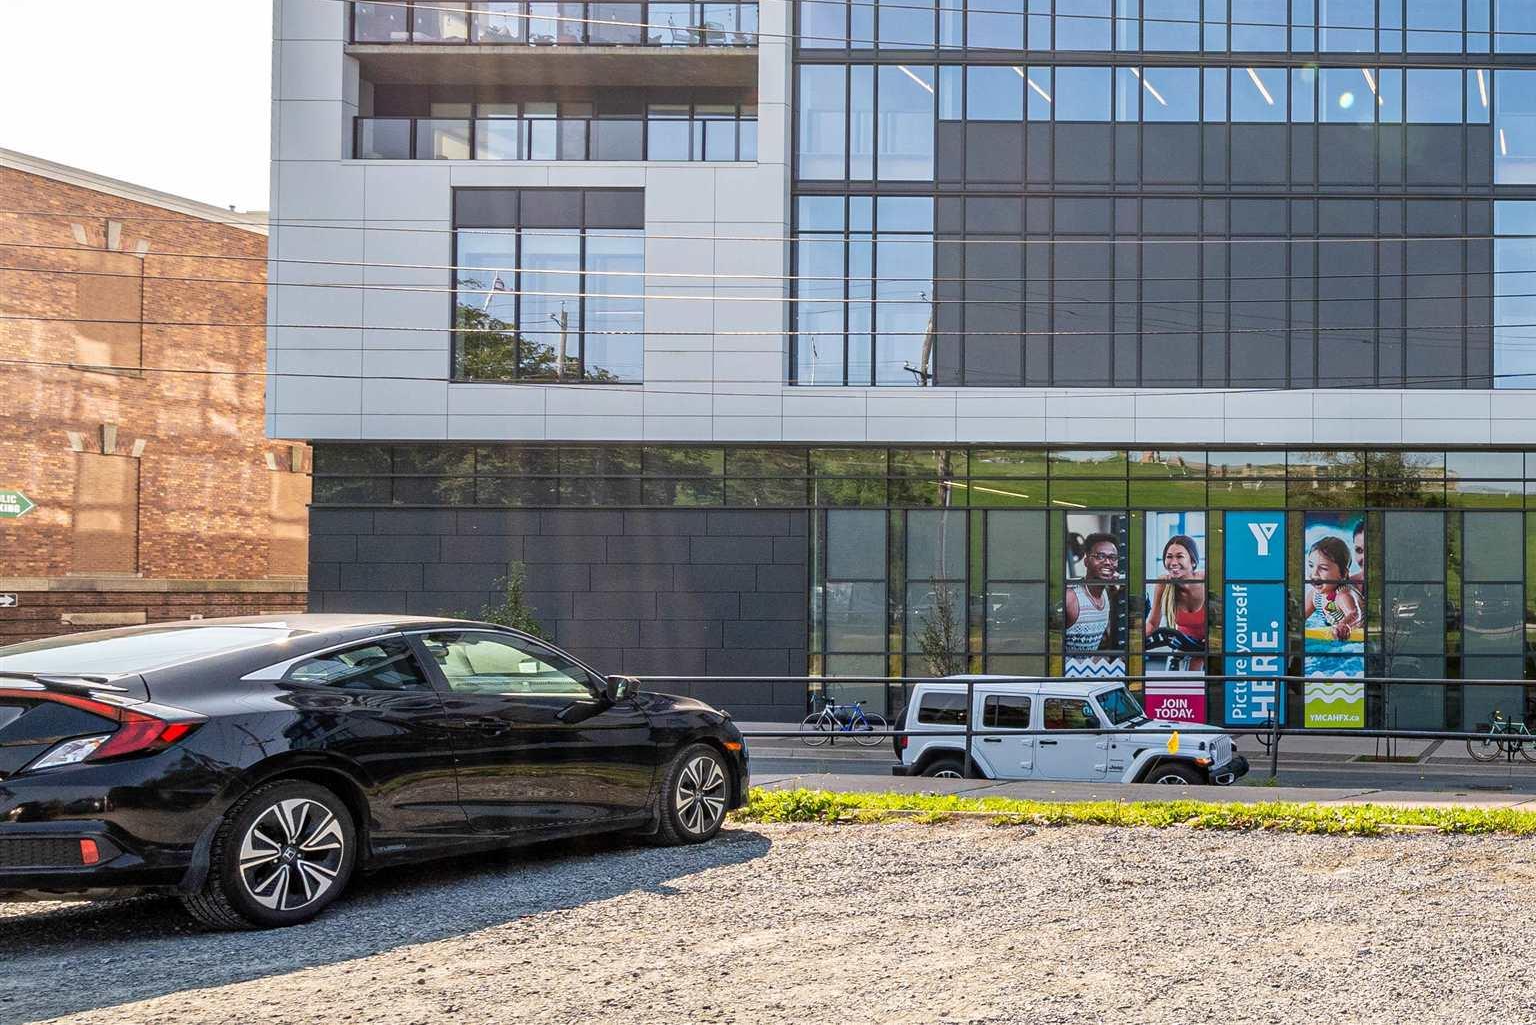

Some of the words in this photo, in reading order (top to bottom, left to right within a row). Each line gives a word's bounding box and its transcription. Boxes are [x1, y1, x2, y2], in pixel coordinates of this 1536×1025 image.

[1232, 584, 1252, 653] yourself
[1251, 621, 1279, 719] HERE.
[1154, 708, 1195, 719] TODAY.
[1161, 698, 1188, 709] JOIN
